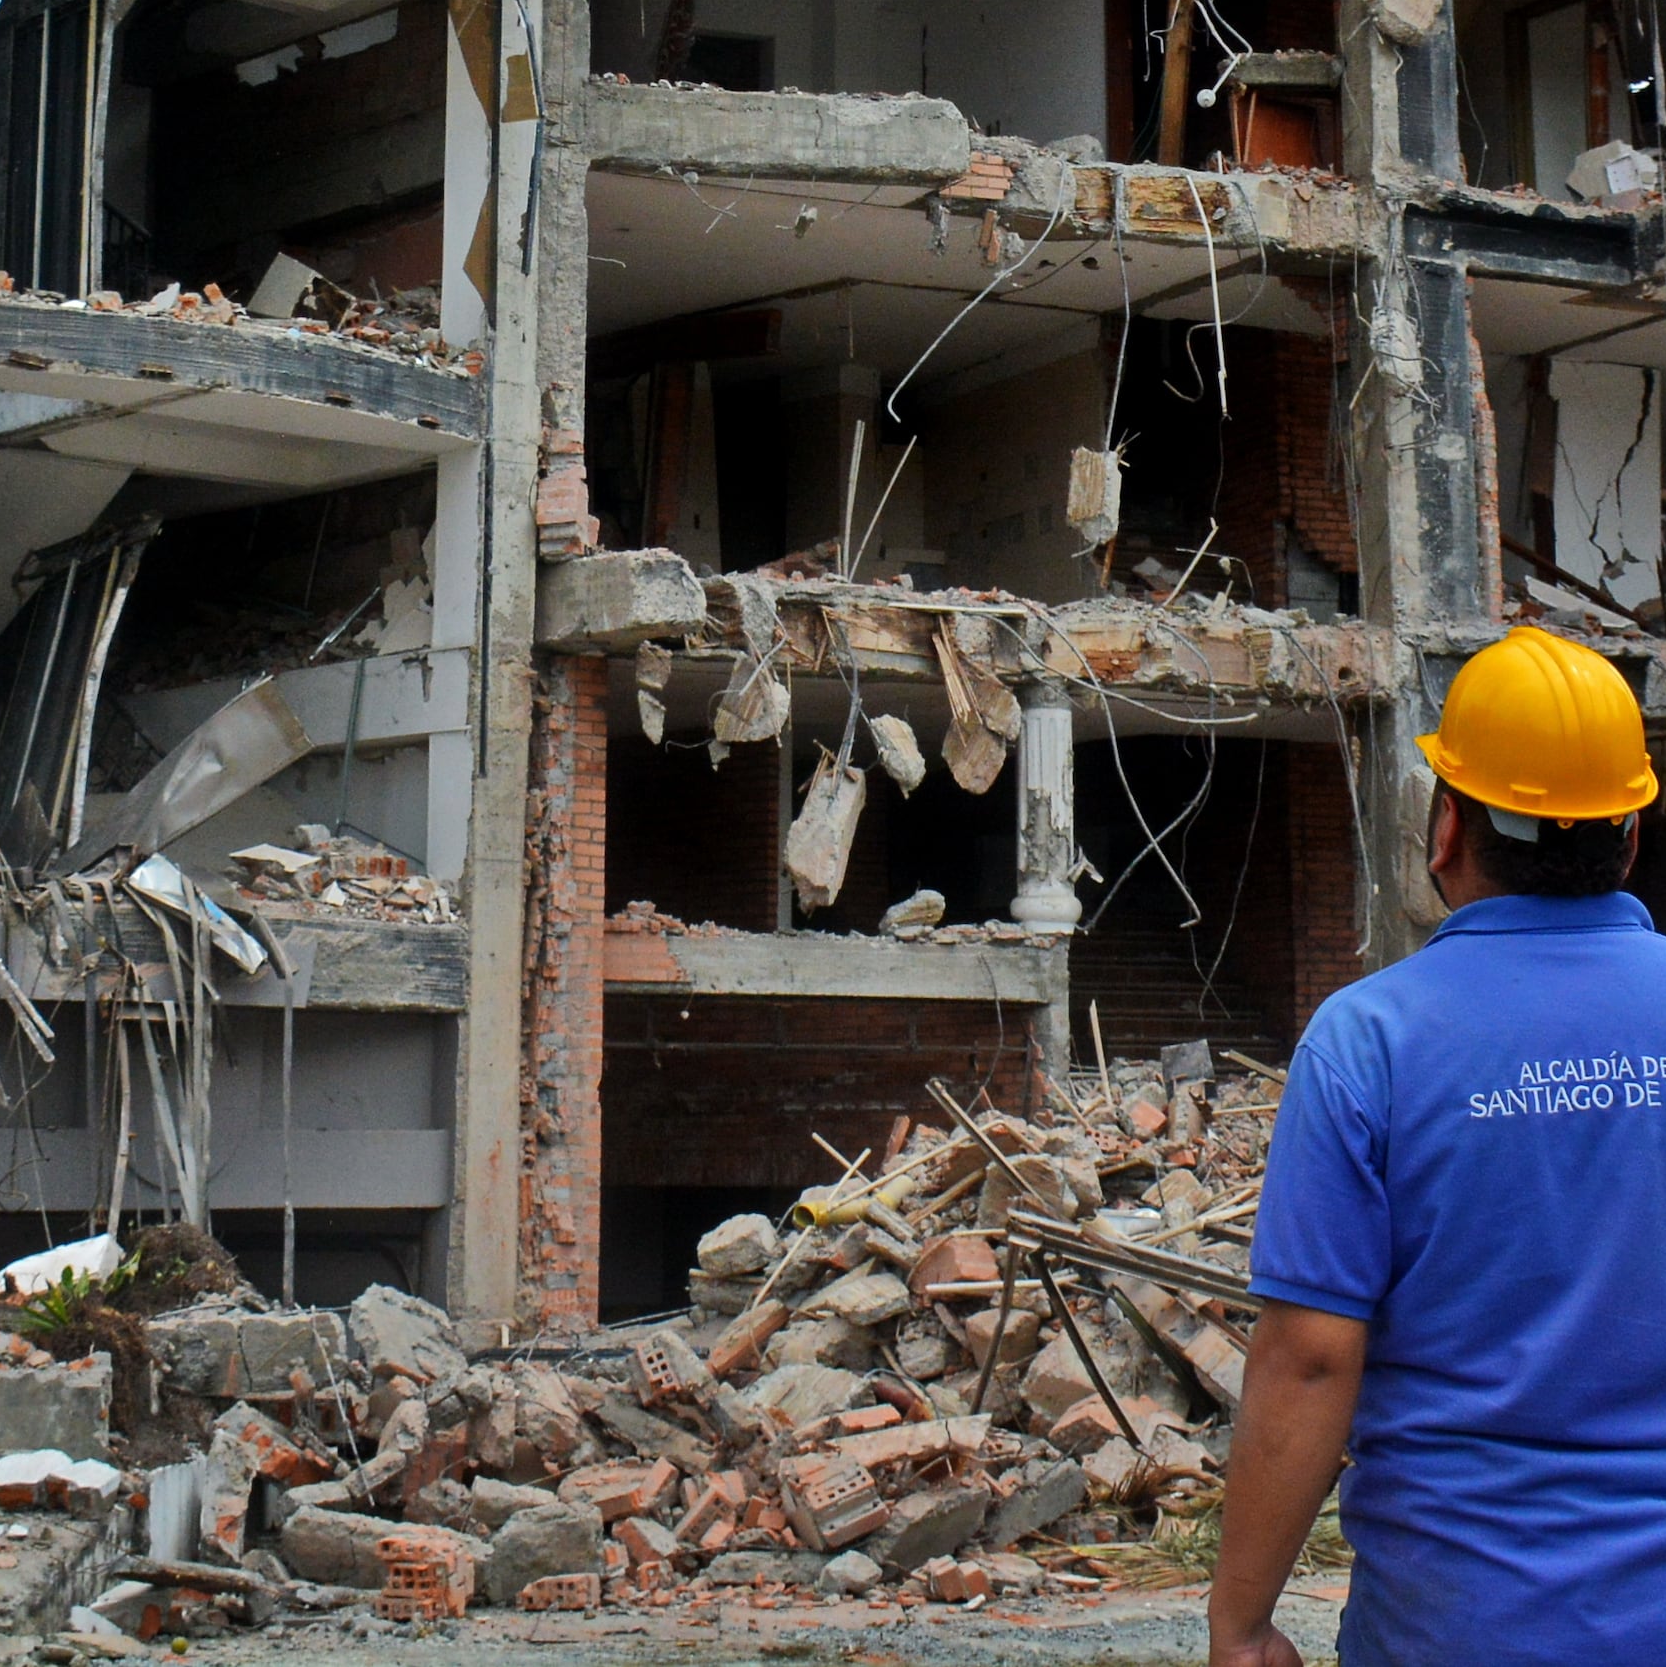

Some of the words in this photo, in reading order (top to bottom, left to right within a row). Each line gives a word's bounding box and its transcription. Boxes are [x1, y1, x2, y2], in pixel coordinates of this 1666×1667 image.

[1519, 1049, 1636, 1086] ALCALDÍA
[1470, 1083, 1614, 1118] SANTIAGO
[1625, 1081, 1661, 1108] DE
